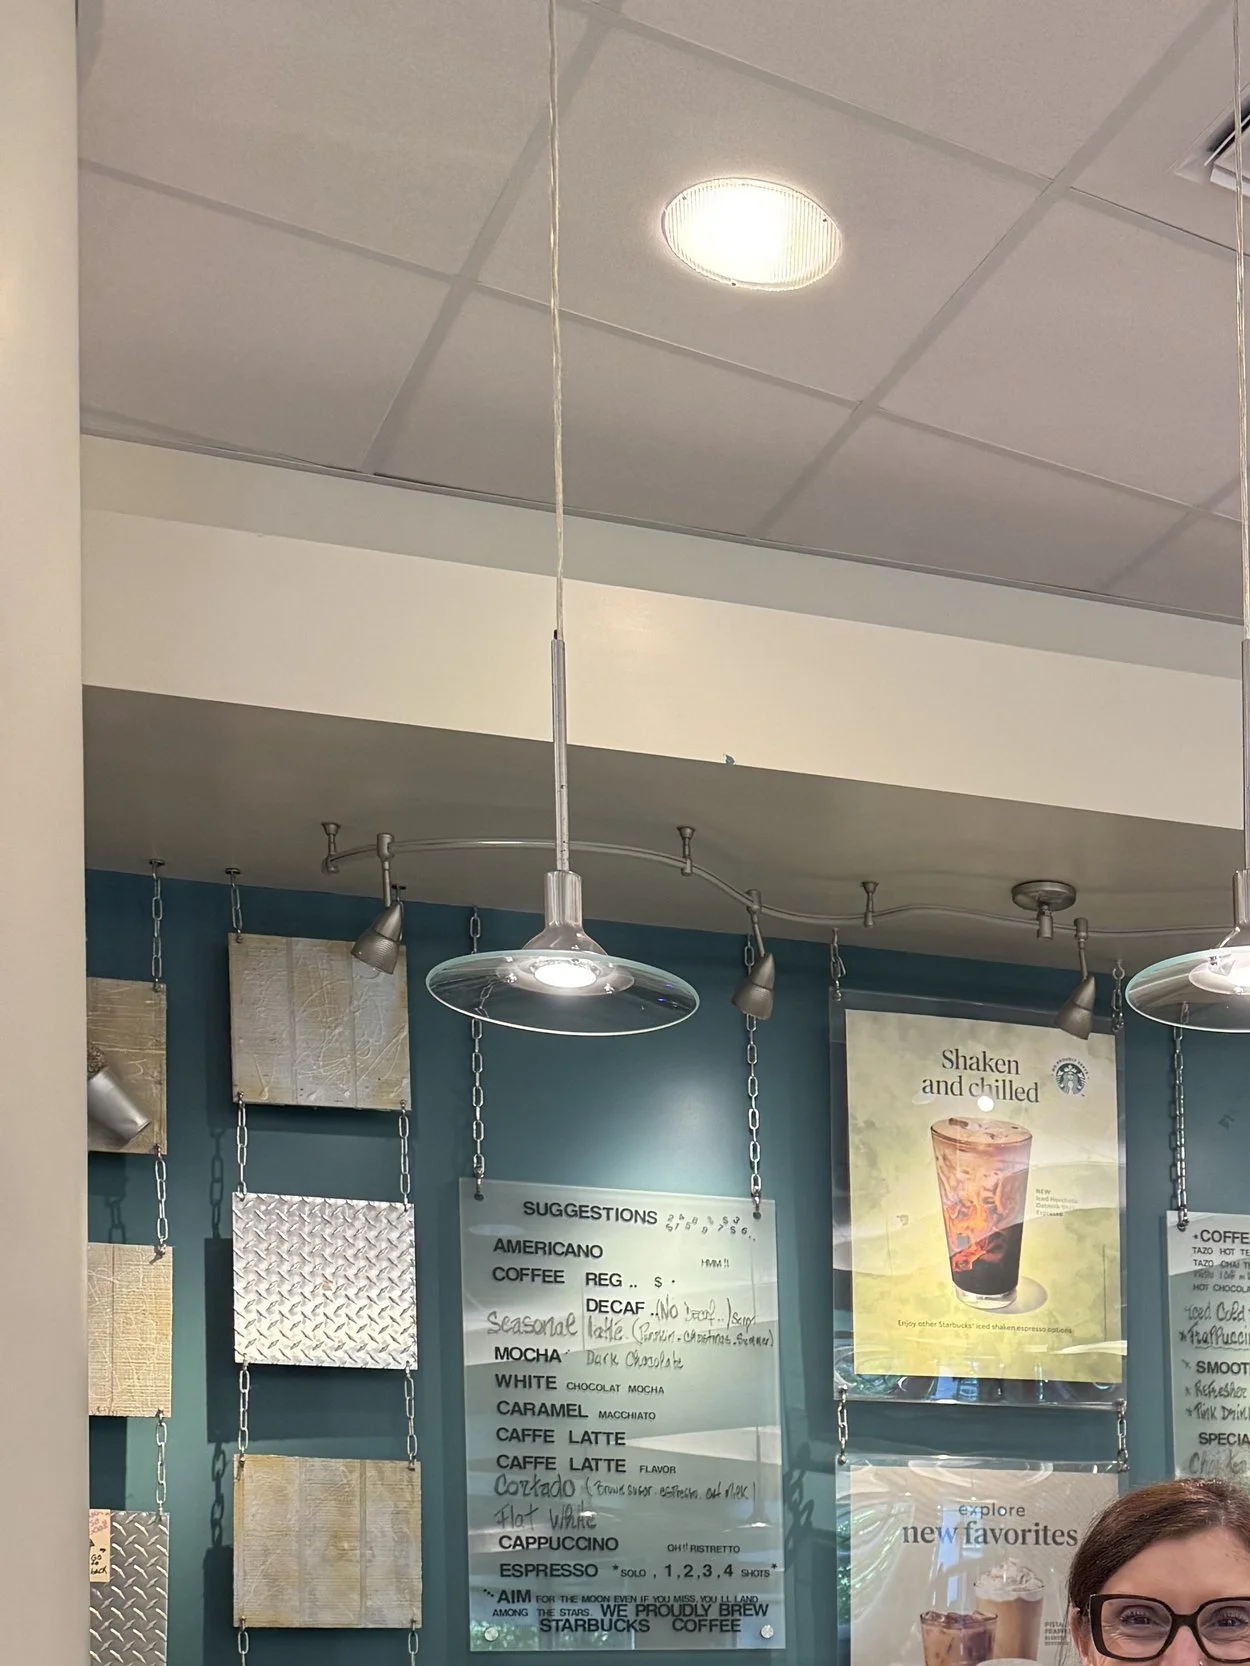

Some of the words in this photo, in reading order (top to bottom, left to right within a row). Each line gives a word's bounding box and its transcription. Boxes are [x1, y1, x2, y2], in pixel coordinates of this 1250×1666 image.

[942, 1048, 1020, 1076] Shaken
[922, 1076, 964, 1098] and
[969, 1077, 1040, 1103] chilled
[523, 1201, 658, 1225] SUGGESTIONS
[493, 1238, 604, 1259] AMERICANO
[1192, 1246, 1213, 1255] TAZO
[1220, 1247, 1235, 1255] HOT
[1192, 1259, 1214, 1268] TAZO
[492, 1267, 565, 1284] COFFEE
[1192, 1284, 1209, 1292] HOT
[586, 1298, 646, 1316] DECAF
[897, 1319, 916, 1328] Enjoy
[1016, 1326, 1047, 1334] espresso
[494, 1347, 562, 1364] MOCHA
[495, 1374, 557, 1390] WHITE
[566, 1382, 621, 1393] CHOCOLAT
[628, 1384, 665, 1395] MOCHA
[496, 1401, 589, 1419] CARAMEL
[598, 1410, 656, 1421] MACCHIATO
[496, 1427, 555, 1443] CAFFE
[569, 1430, 626, 1446] LATTE
[496, 1454, 557, 1471] CAFFE
[569, 1457, 627, 1473] LATTE
[639, 1464, 676, 1474] FLAVOR
[958, 1503, 1026, 1519] explore
[902, 1524, 959, 1545] new
[963, 1520, 1079, 1547] favorites
[499, 1535, 619, 1552] CAPPUCCINO
[690, 1544, 741, 1554] RISTRETTO
[499, 1563, 599, 1578] ESPRESSO
[536, 1595, 555, 1604] FOR
[560, 1595, 578, 1604] THE
[581, 1595, 610, 1604] MOON
[614, 1595, 637, 1604] EVEN
[641, 1595, 649, 1604] IF
[652, 1595, 670, 1604] YOU
[492, 1608, 528, 1617] AMONG
[537, 1608, 555, 1617] THE
[601, 1604, 628, 1618] WE
[635, 1604, 712, 1618] PROUDLY
[719, 1603, 769, 1617] BREW
[540, 1618, 651, 1633] STARBUCKS
[671, 1618, 742, 1633] COFFEE
